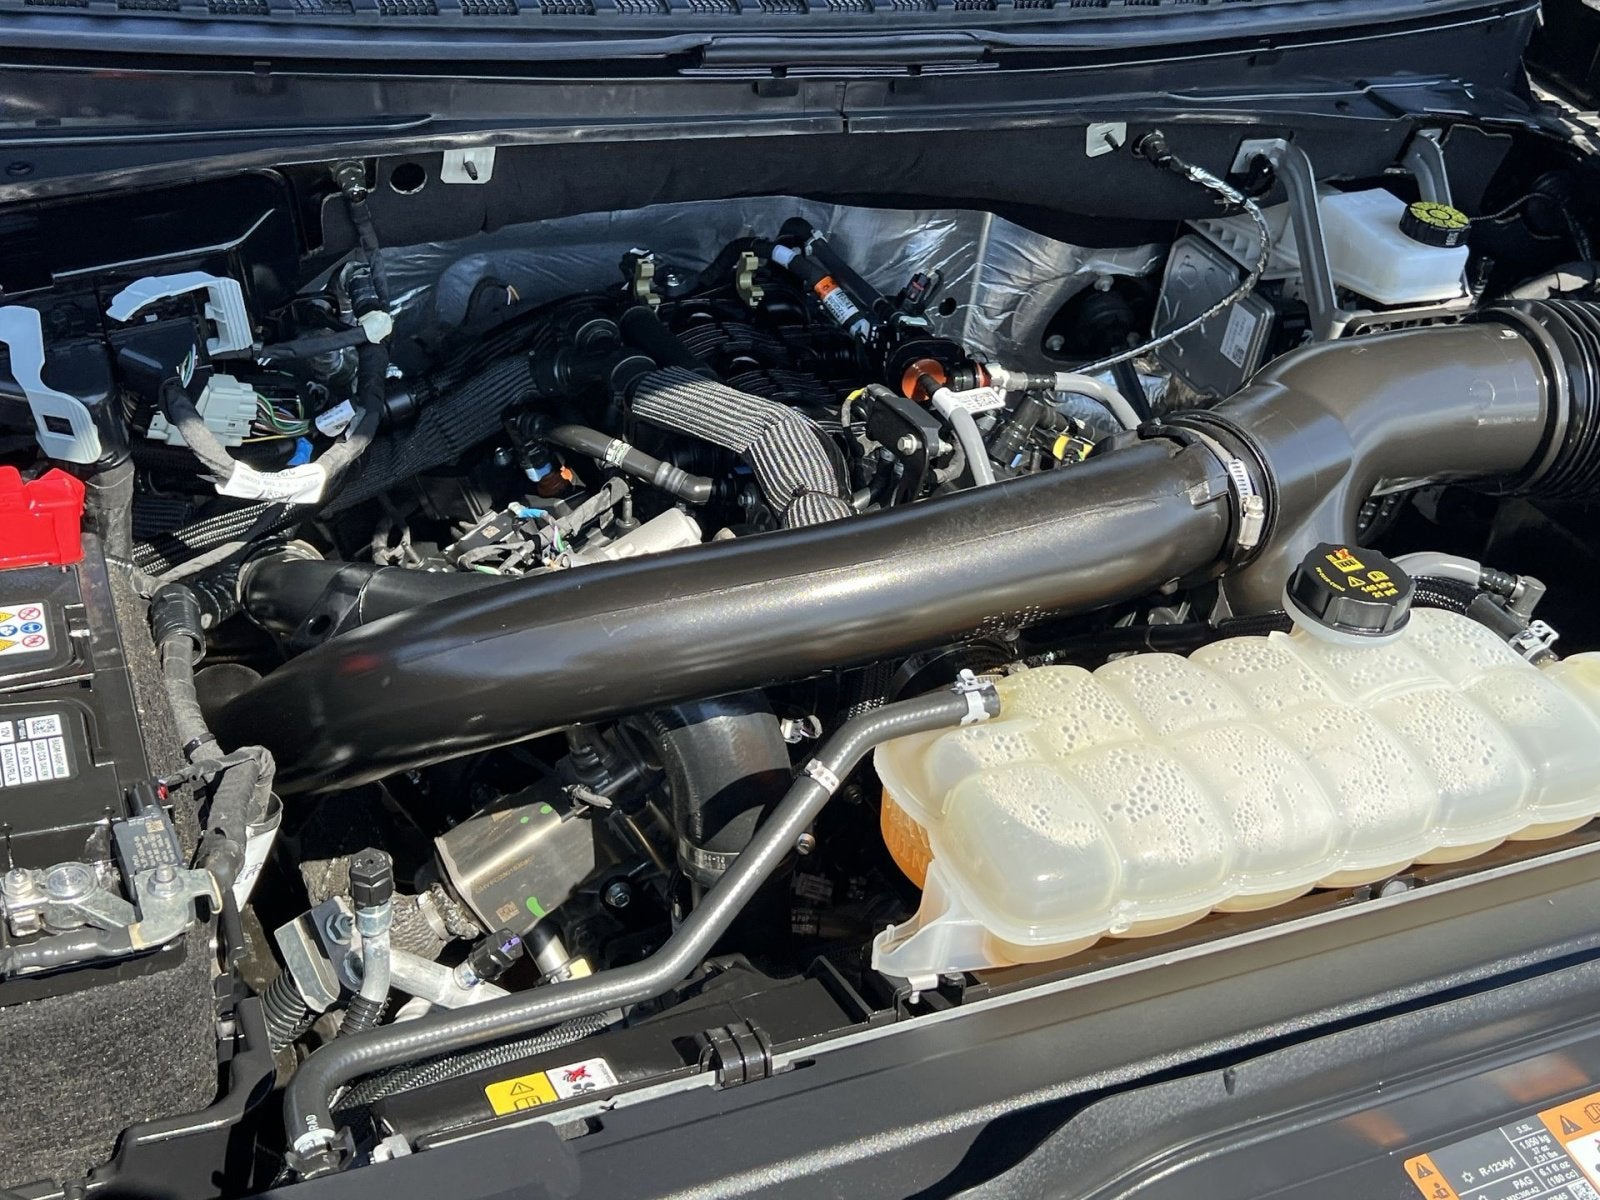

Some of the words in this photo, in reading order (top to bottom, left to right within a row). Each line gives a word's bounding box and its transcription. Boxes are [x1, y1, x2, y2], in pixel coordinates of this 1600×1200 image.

[1515, 1123, 1533, 1134] 3.5L
[1538, 1134, 1552, 1144] kg
[1531, 1146, 1541, 1155] 37
[1478, 1156, 1517, 1177] R-1234yf
[1538, 1165, 1552, 1177] 6.1
[1551, 1162, 1560, 1172] fl
[1559, 1161, 1571, 1169] oz
[1565, 1169, 1580, 1179] cc)
[1512, 1175, 1534, 1190] PAG
